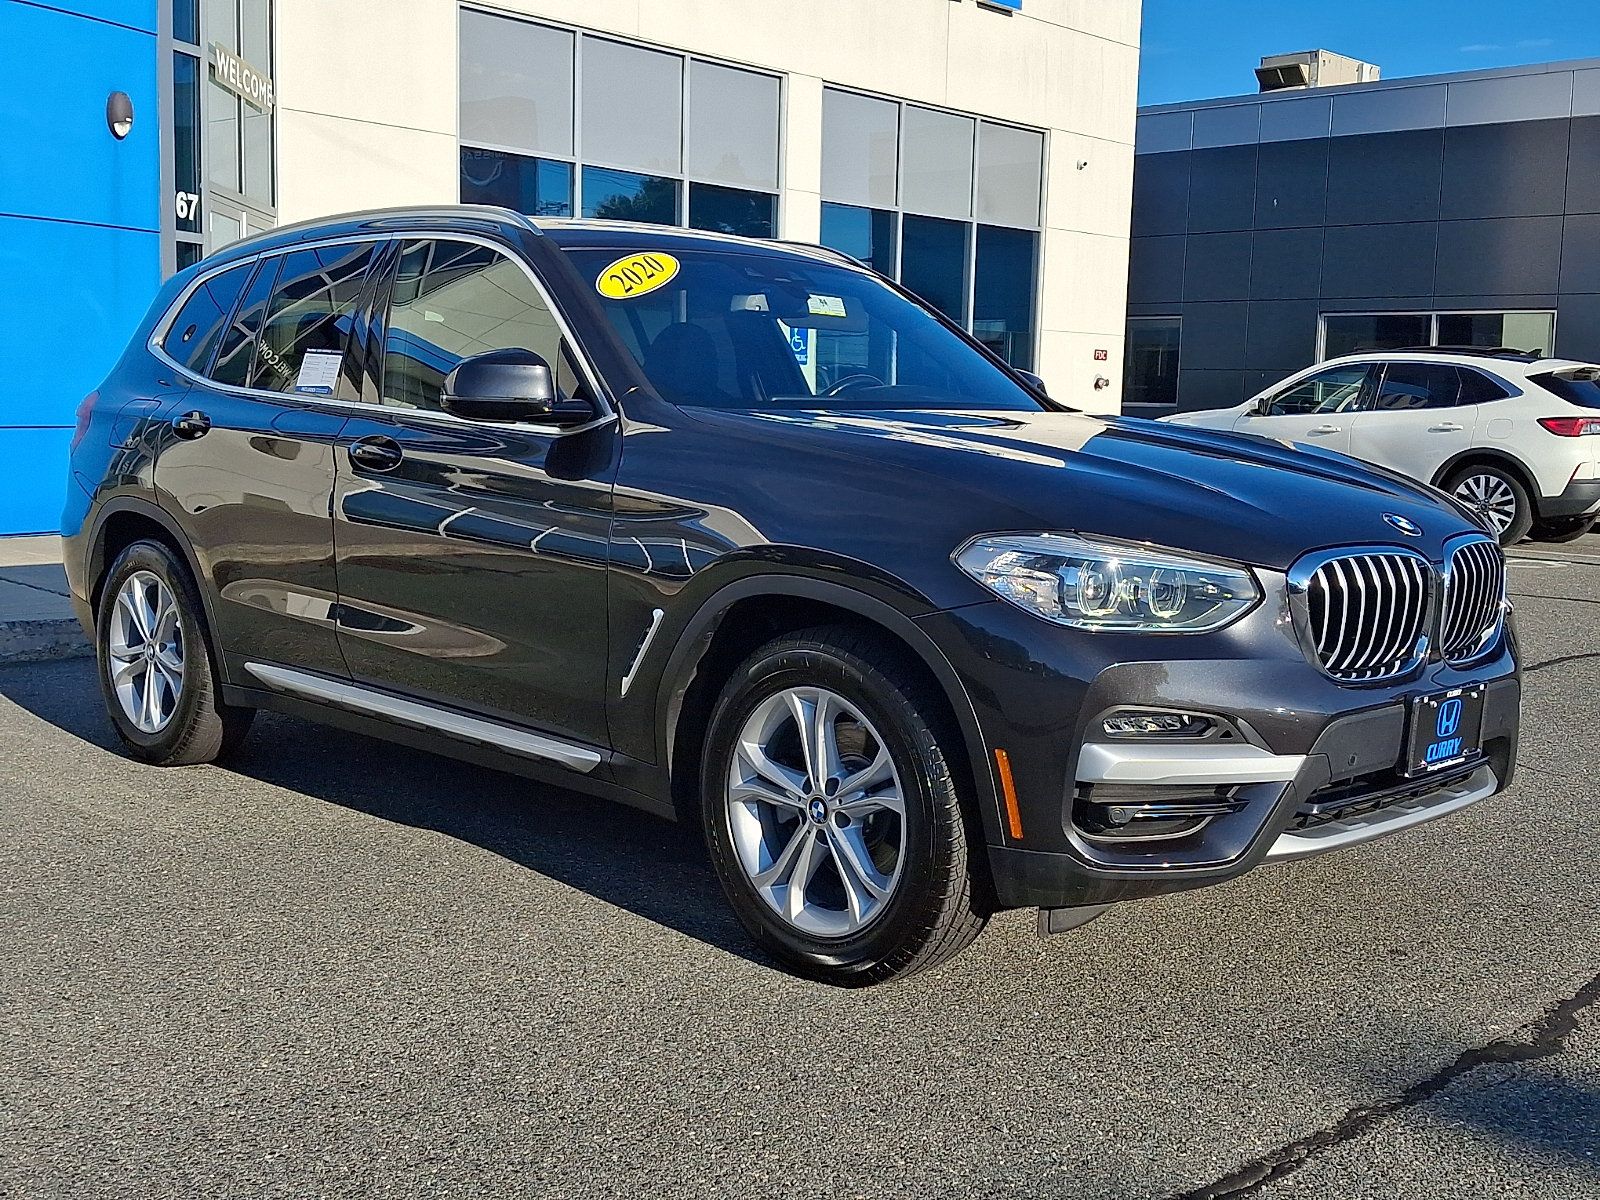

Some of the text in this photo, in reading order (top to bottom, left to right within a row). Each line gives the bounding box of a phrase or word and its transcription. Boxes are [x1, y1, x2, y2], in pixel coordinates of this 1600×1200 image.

[215, 48, 273, 108] WELCOME
[176, 191, 198, 220] 67
[609, 256, 664, 293] 2020
[1426, 737, 1462, 761] CURRY
